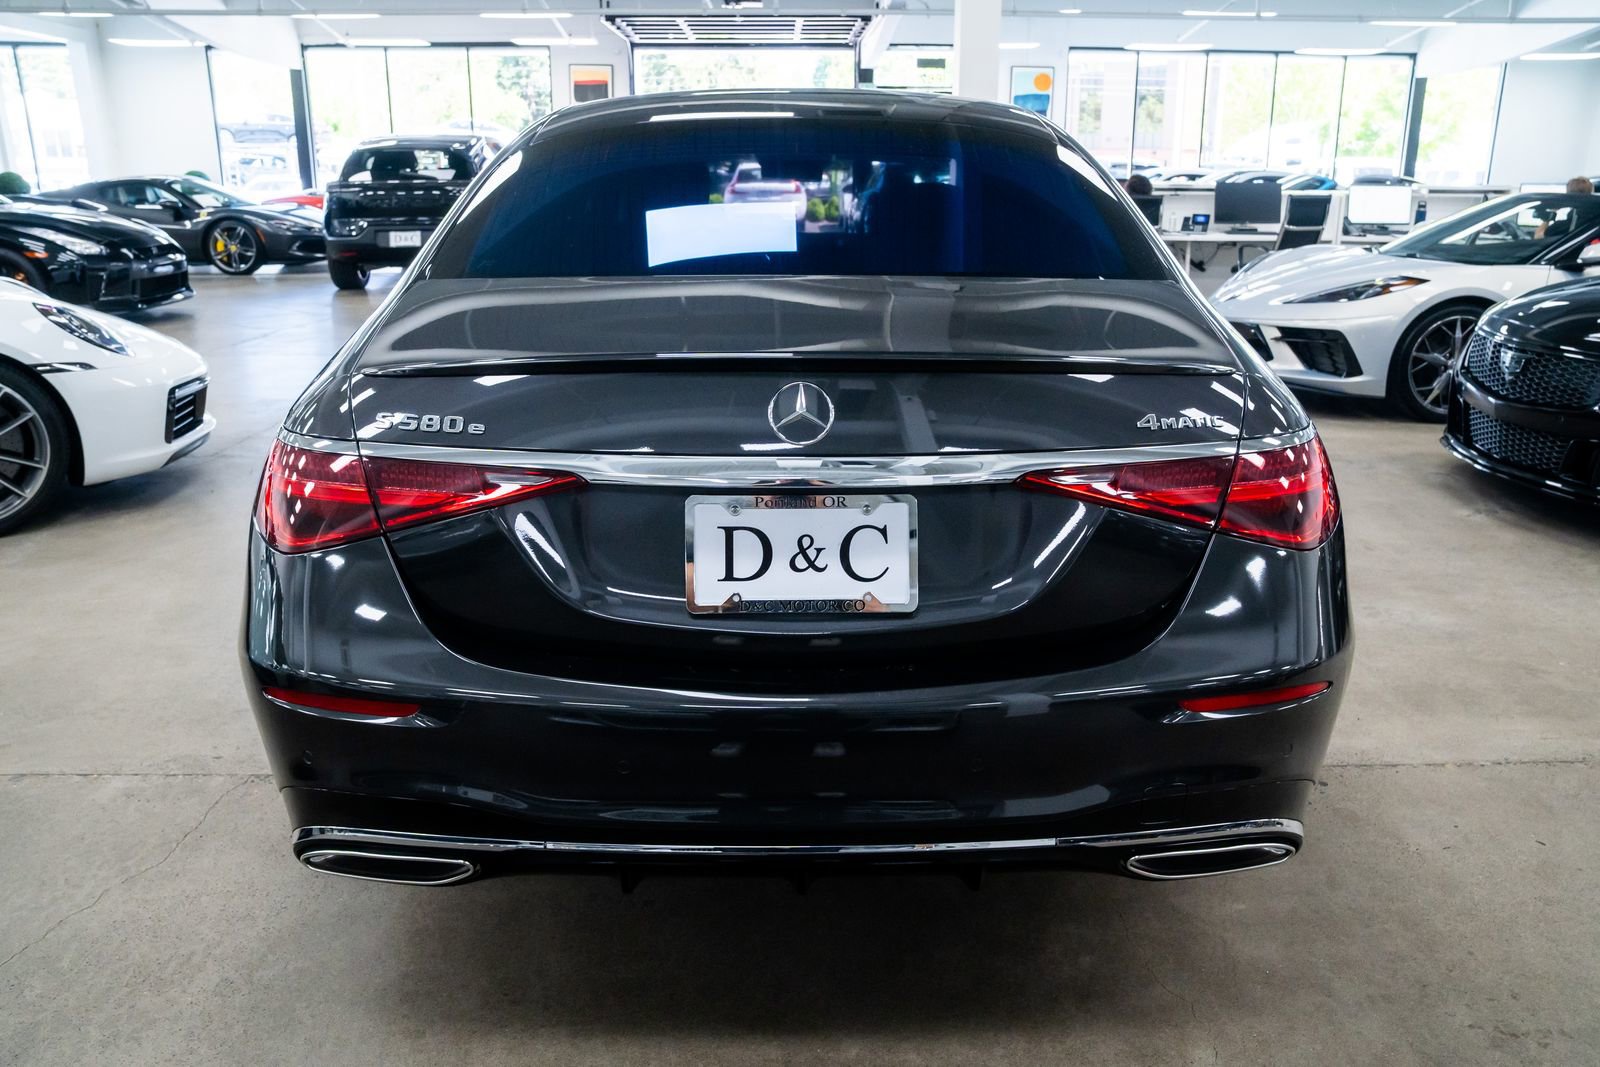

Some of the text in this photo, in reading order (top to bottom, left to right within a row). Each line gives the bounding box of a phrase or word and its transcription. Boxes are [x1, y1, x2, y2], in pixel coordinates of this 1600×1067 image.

[1136, 413, 1224, 431] 4MATIC
[754, 495, 848, 508] Portland OR
[717, 524, 889, 583] D & C
[778, 600, 839, 613] MOTOR
[842, 600, 866, 612] CO
